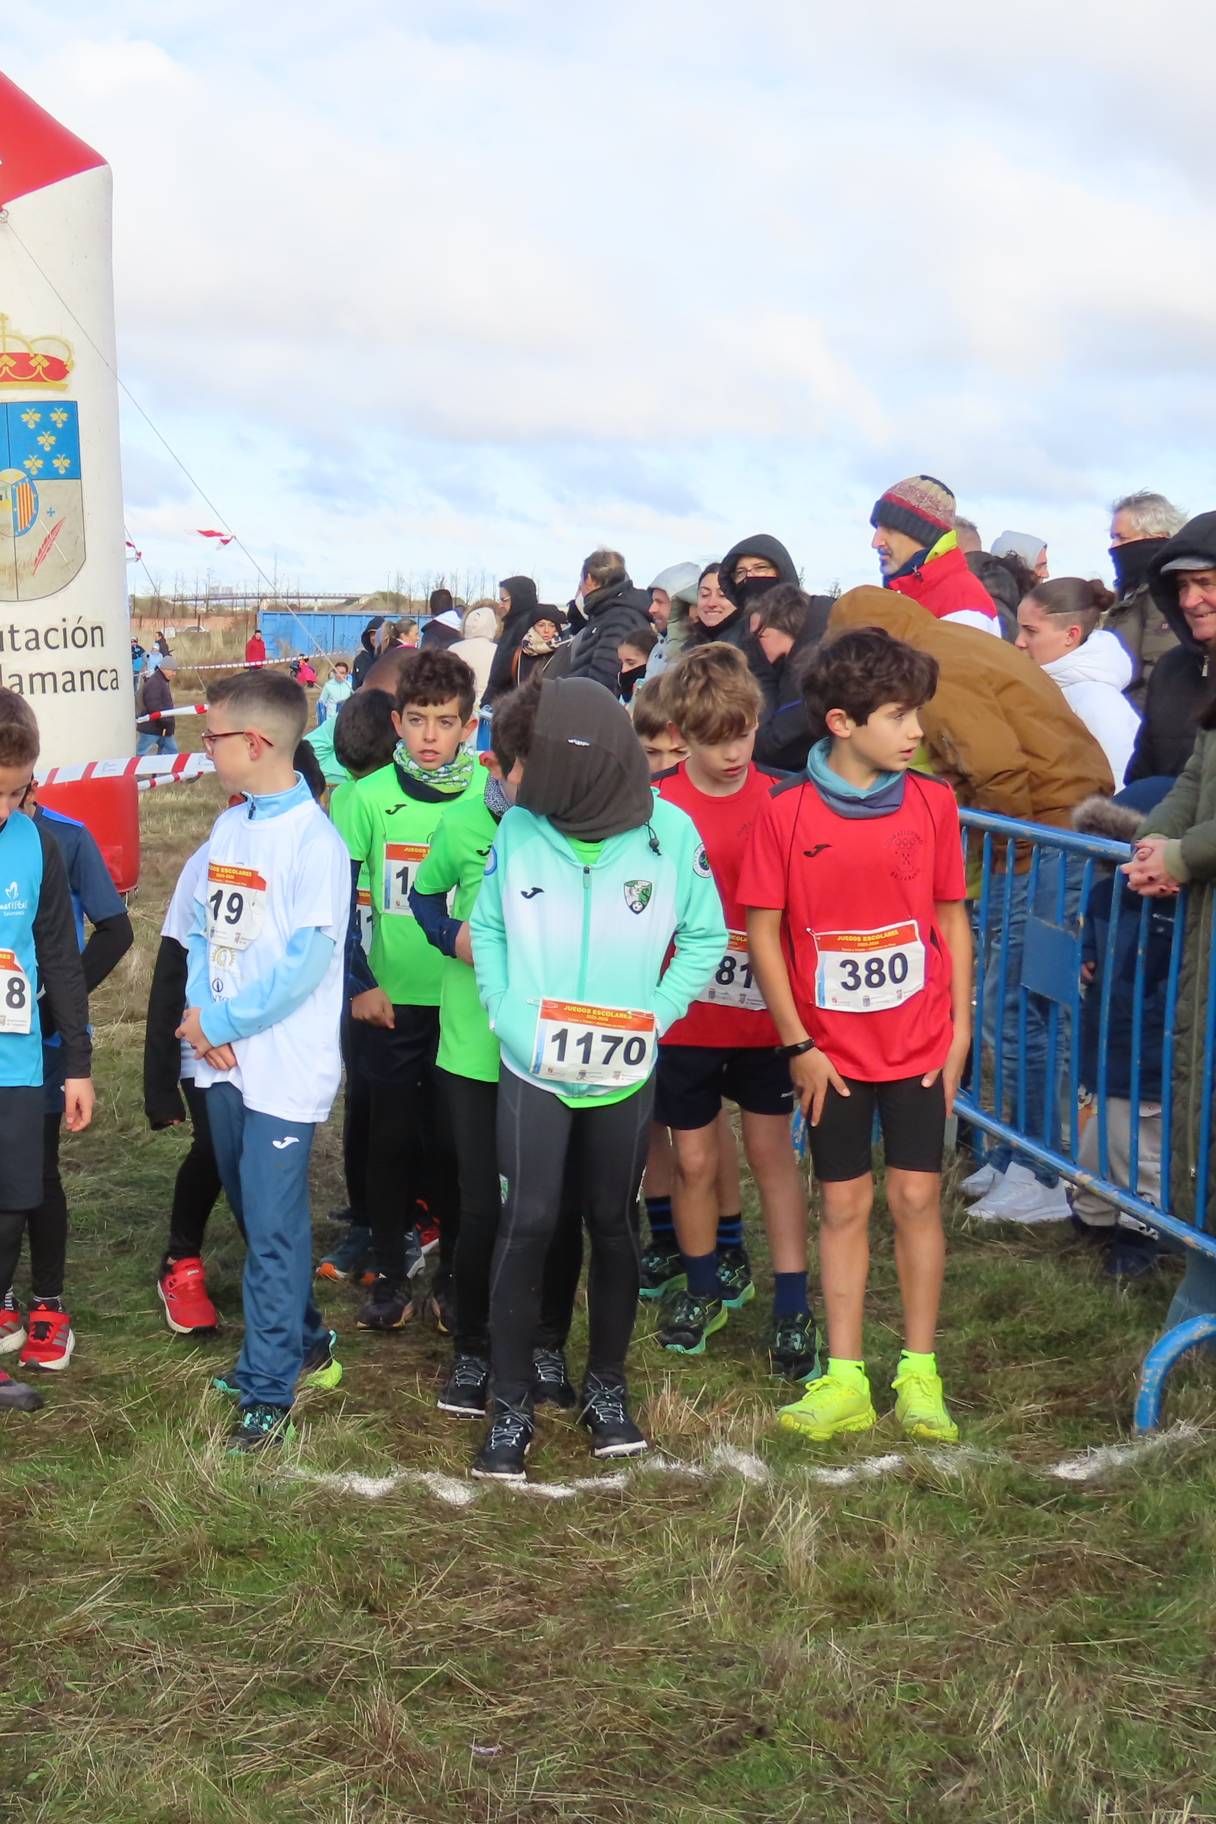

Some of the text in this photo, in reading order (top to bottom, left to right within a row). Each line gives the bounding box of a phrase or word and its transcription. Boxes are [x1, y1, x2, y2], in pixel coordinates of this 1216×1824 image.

[209, 889, 244, 925] 19
[863, 929, 900, 942] ESCOLARES
[839, 952, 909, 991] 380
[563, 1004, 591, 1014] JUEGOS
[551, 1028, 647, 1066] 1170
